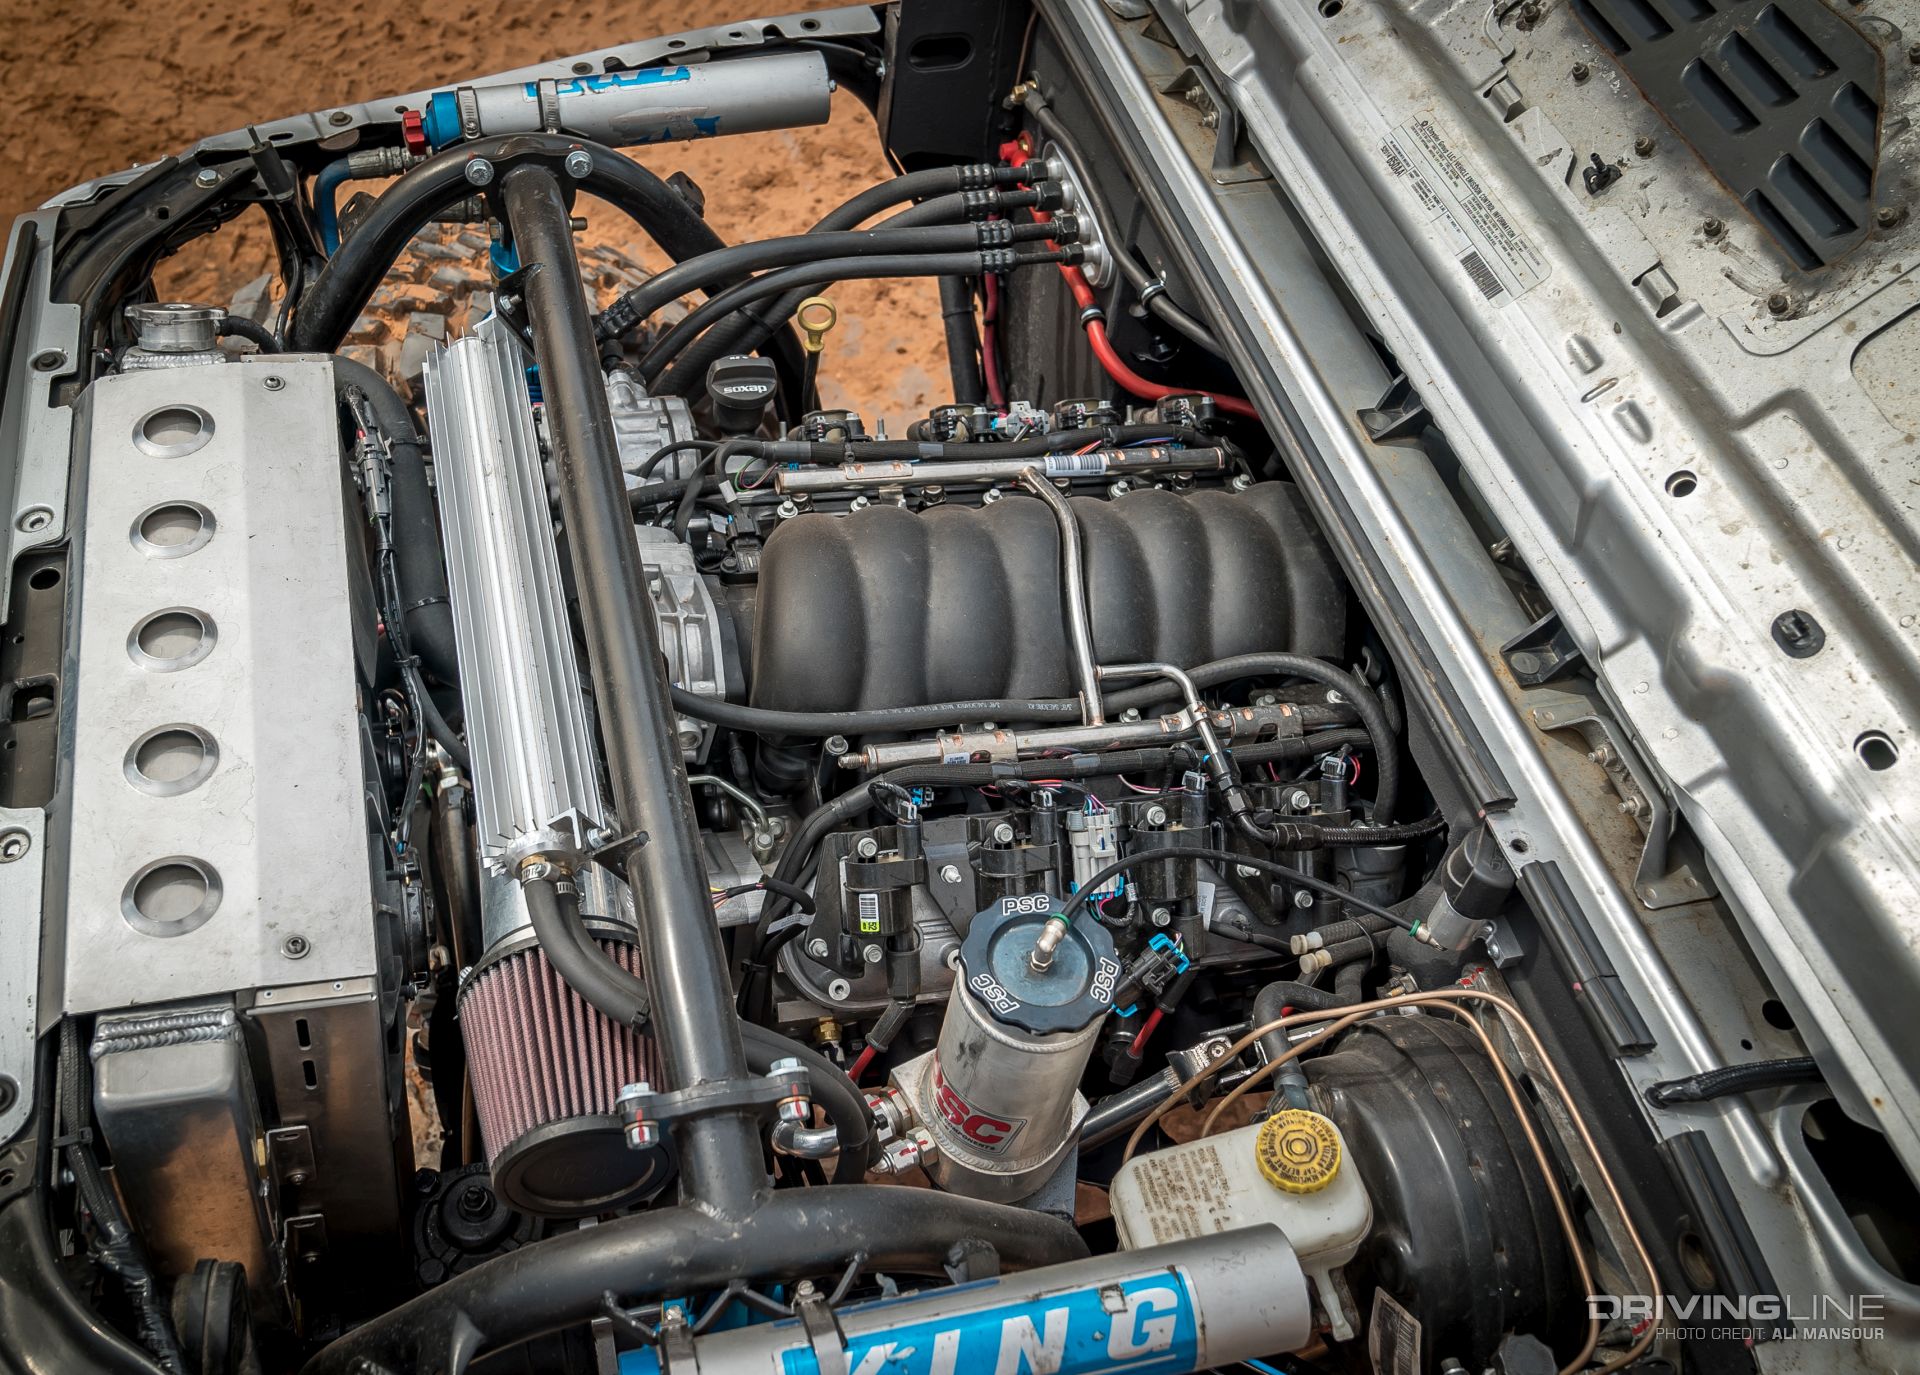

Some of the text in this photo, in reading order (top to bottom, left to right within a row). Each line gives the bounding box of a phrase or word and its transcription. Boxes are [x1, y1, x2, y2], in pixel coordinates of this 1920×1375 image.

[1426, 126, 1457, 162] Chrysler Group LLC
[1454, 160, 1517, 240] VEHICLE EMISSION CONTROL INFORMATION
[724, 384, 767, 394] dexos
[1003, 894, 1049, 916] PSC
[972, 973, 1020, 1014] PSC
[1090, 957, 1119, 1004] PSC
